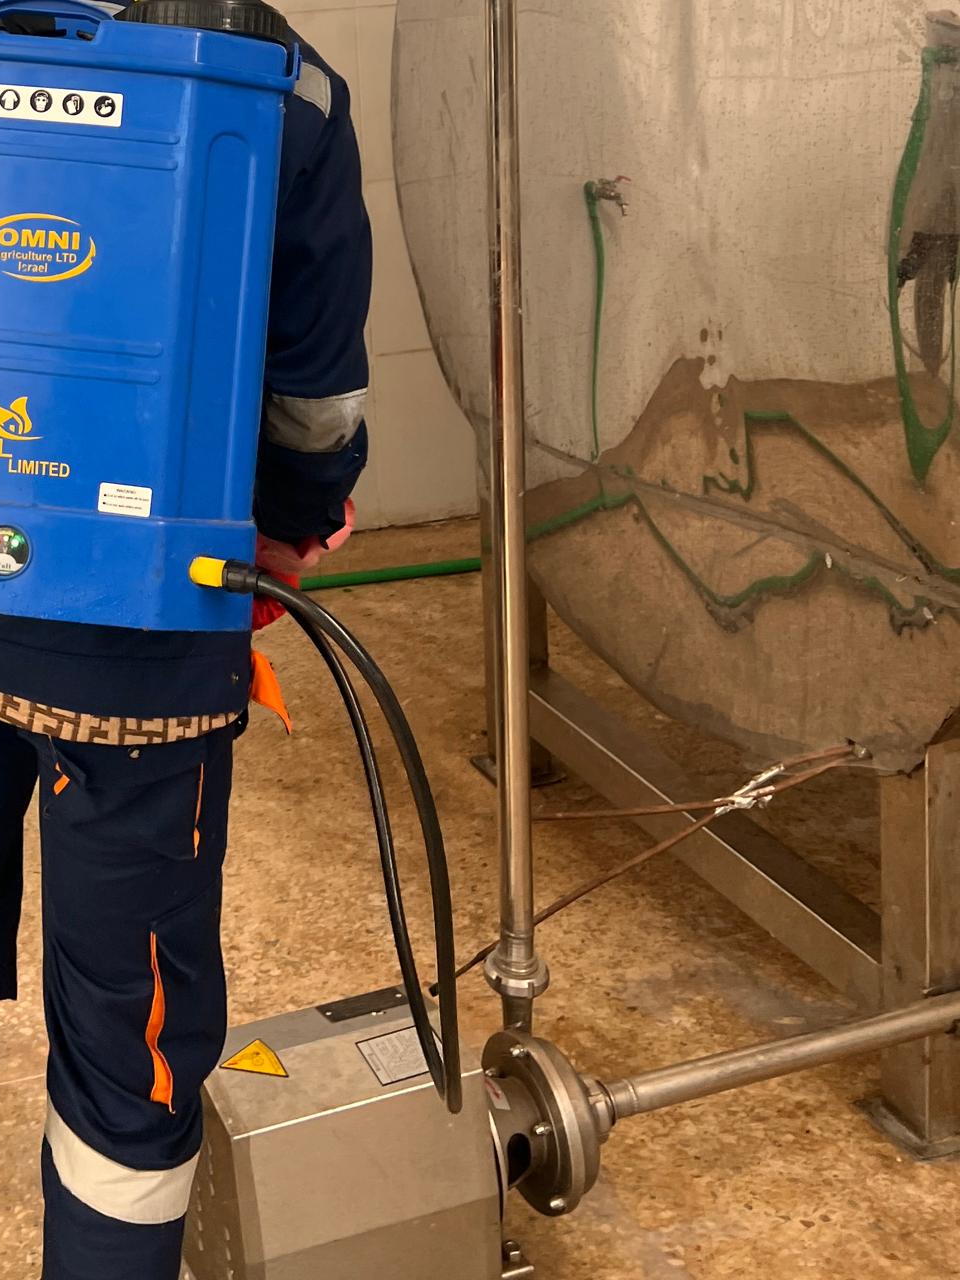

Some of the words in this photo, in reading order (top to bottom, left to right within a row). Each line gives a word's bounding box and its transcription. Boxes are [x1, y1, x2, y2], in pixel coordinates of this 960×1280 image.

[55, 252, 77, 263] LTD
[18, 261, 48, 273] Israel
[8, 459, 71, 478] LIMITED
